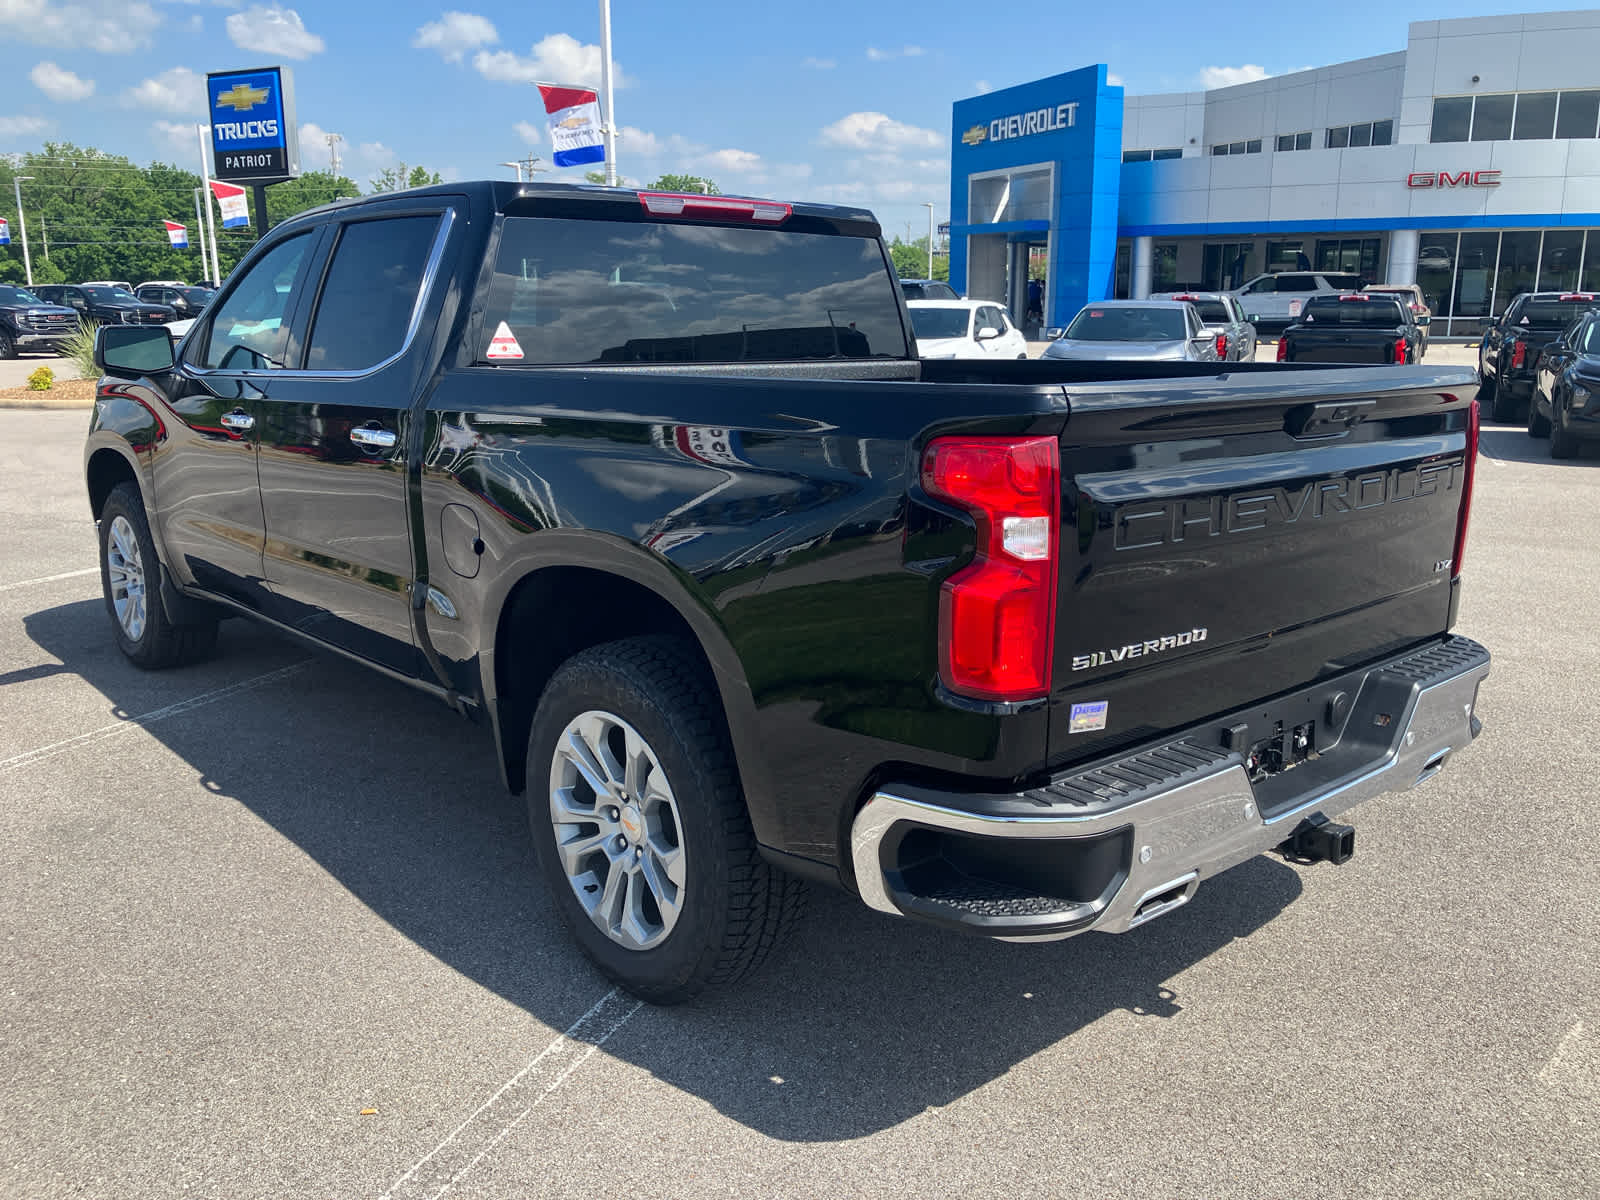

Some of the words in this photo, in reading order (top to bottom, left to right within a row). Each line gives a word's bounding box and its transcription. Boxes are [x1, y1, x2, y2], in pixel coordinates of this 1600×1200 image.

[214, 119, 278, 140] TRUCKS
[990, 102, 1079, 142] CHEVROLET
[225, 154, 272, 168] PATRIOT
[1407, 170, 1502, 188] GMC
[1113, 456, 1464, 551] CHEVROLET
[1071, 627, 1208, 672] SILVERADO
